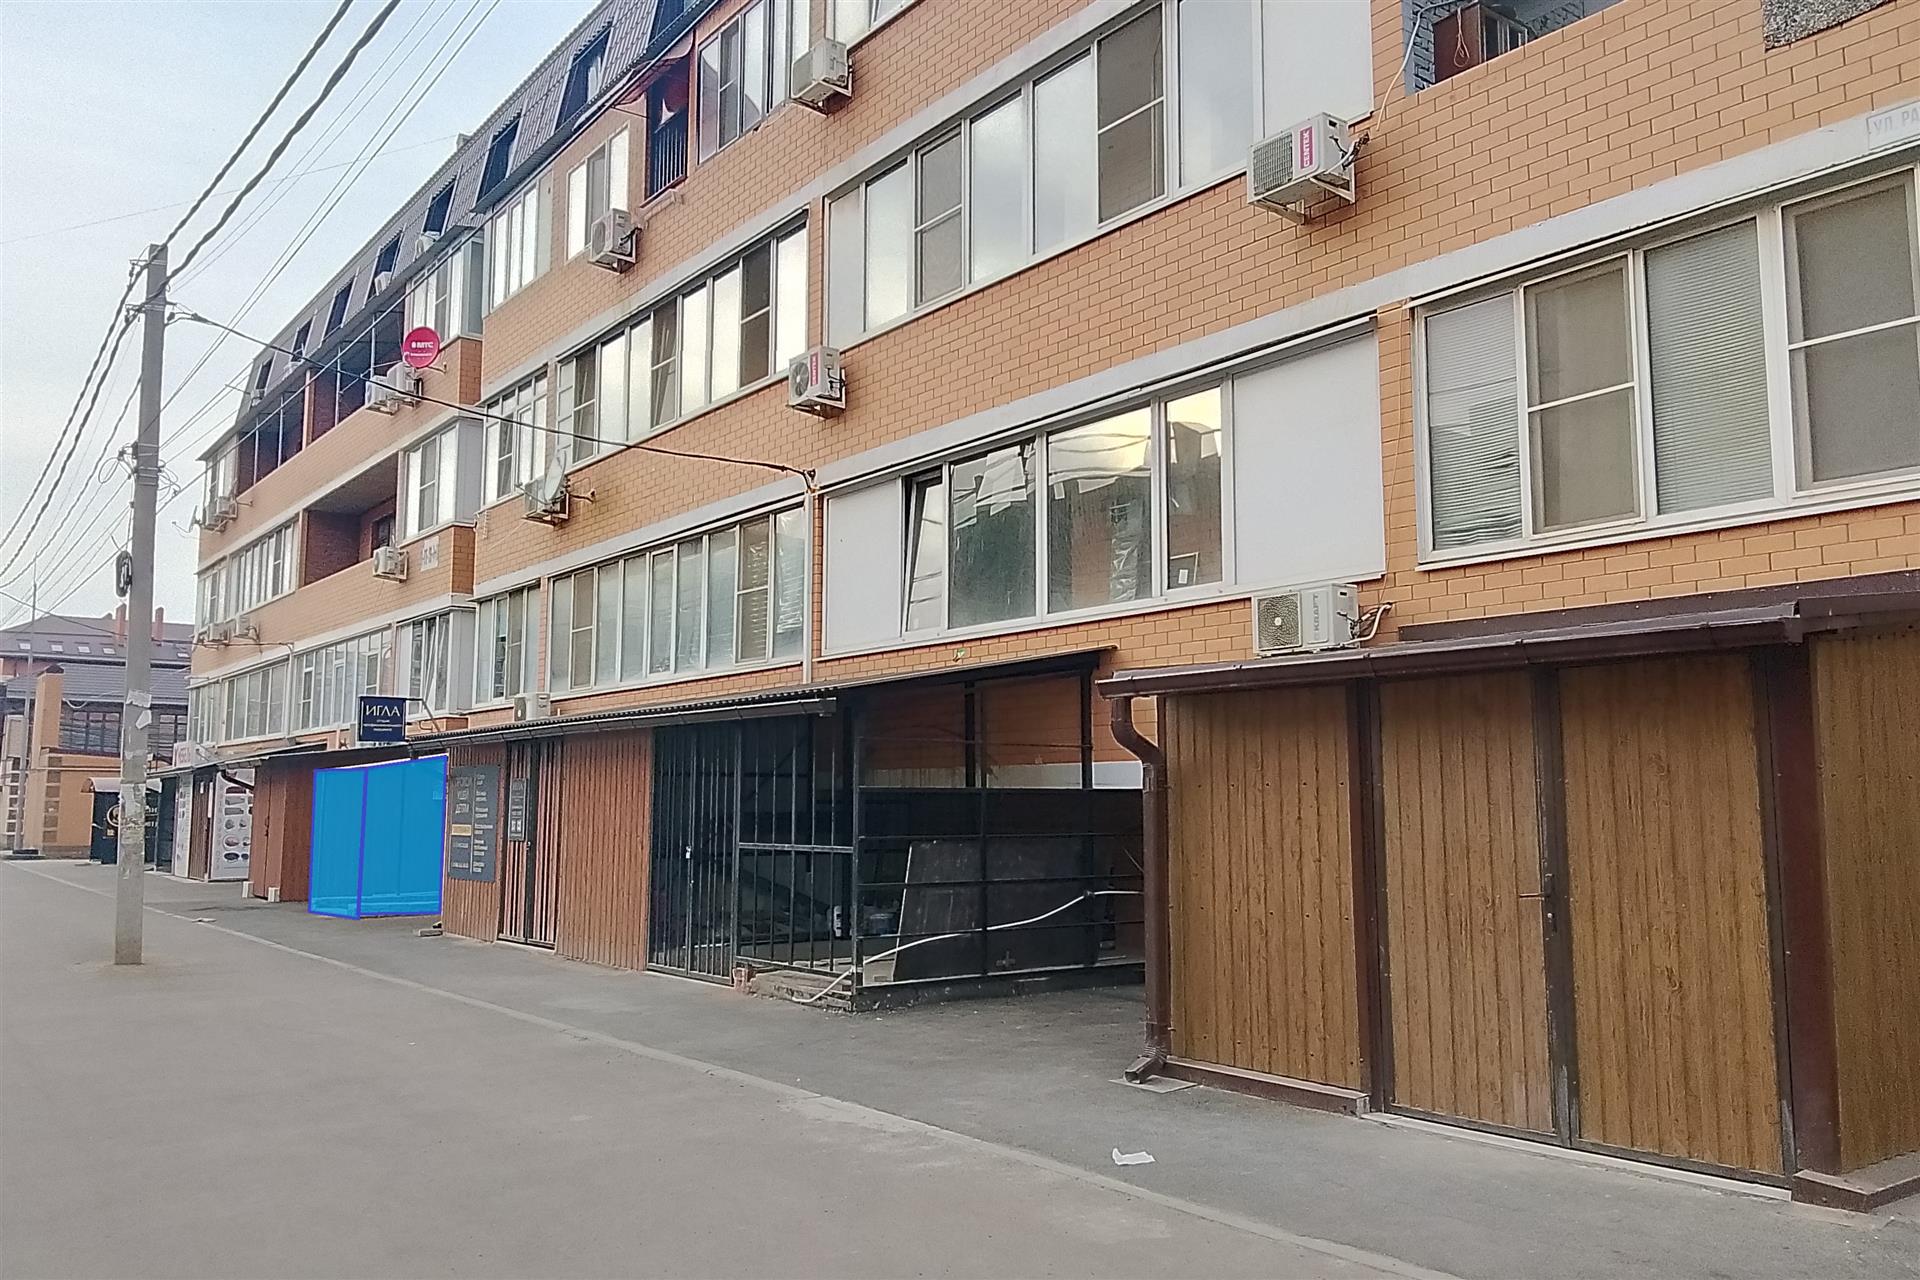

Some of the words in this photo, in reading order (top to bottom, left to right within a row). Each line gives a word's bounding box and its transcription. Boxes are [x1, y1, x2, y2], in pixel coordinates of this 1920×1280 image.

[1901, 106, 1920, 127] РА
[1302, 130, 1311, 168] CENTEK
[365, 704, 401, 717] ИГЛА
